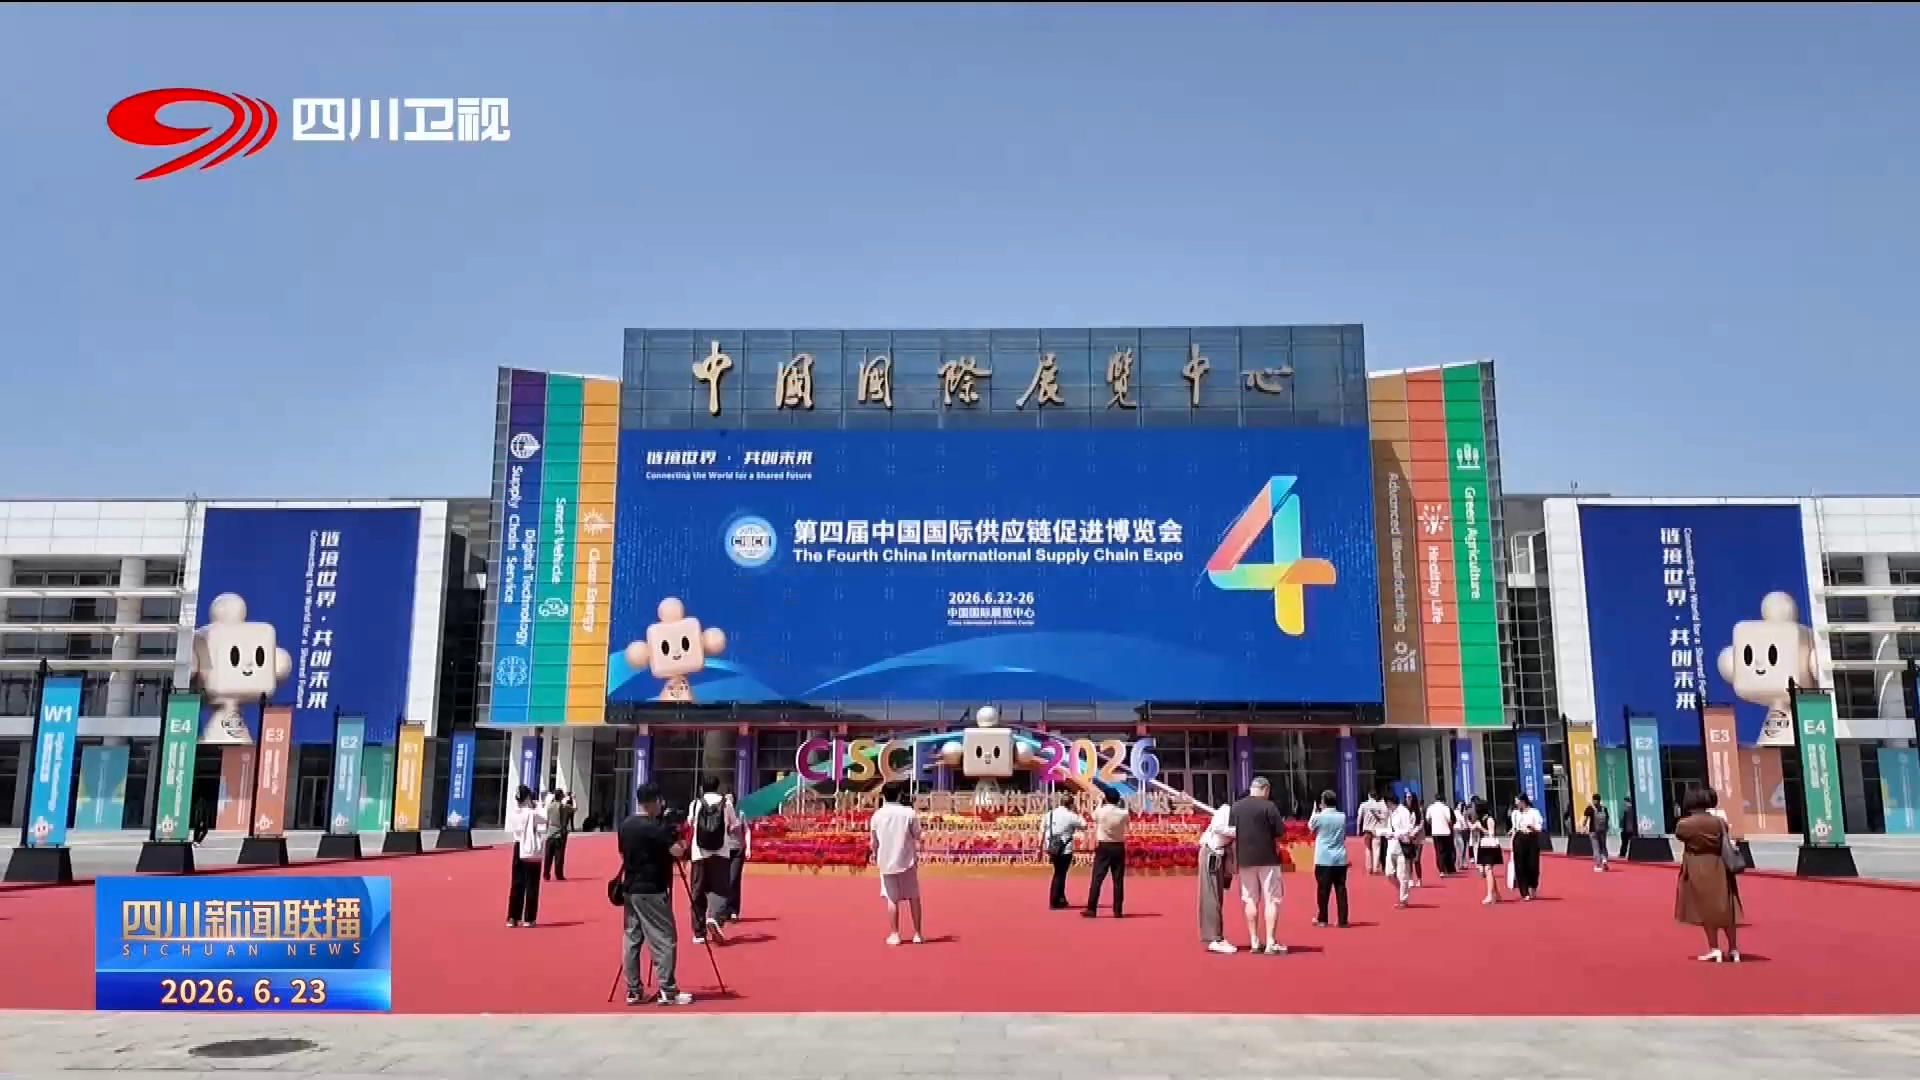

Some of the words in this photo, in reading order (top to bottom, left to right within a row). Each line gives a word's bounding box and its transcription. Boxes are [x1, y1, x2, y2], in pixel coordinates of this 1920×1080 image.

[508, 465, 524, 509] Supply
[645, 471, 691, 481] Connecting
[692, 471, 706, 480] the
[708, 471, 733, 480] World
[555, 497, 566, 535] Smart
[1389, 472, 1400, 535] Advanced
[1464, 487, 1477, 525] Green
[507, 513, 521, 551] Chain
[522, 529, 537, 571] Digital
[793, 517, 1183, 545] 第四届中国国际供应链促进博览会
[552, 536, 565, 584] Vehicle
[792, 548, 823, 563] The
[827, 548, 878, 563] Fourth
[882, 548, 928, 563] China
[931, 548, 1031, 563] International
[1035, 548, 1089, 565] Supply
[1093, 548, 1139, 563] Chain
[1143, 548, 1184, 565] Expo
[1428, 545, 1443, 597] Healthy
[1464, 527, 1481, 599] Agriculture
[505, 556, 518, 603] Service
[948, 591, 1035, 605] 2026.6.22-26
[516, 573, 534, 646] Technology
[1431, 600, 1444, 625] Life
[43, 705, 73, 723] W1
[170, 719, 192, 734] E4
[1803, 719, 1827, 735] E4
[265, 727, 285, 743] E3
[1709, 728, 1730, 743] E3
[796, 738, 934, 782] CISCE
[1040, 738, 1160, 783] 2026
